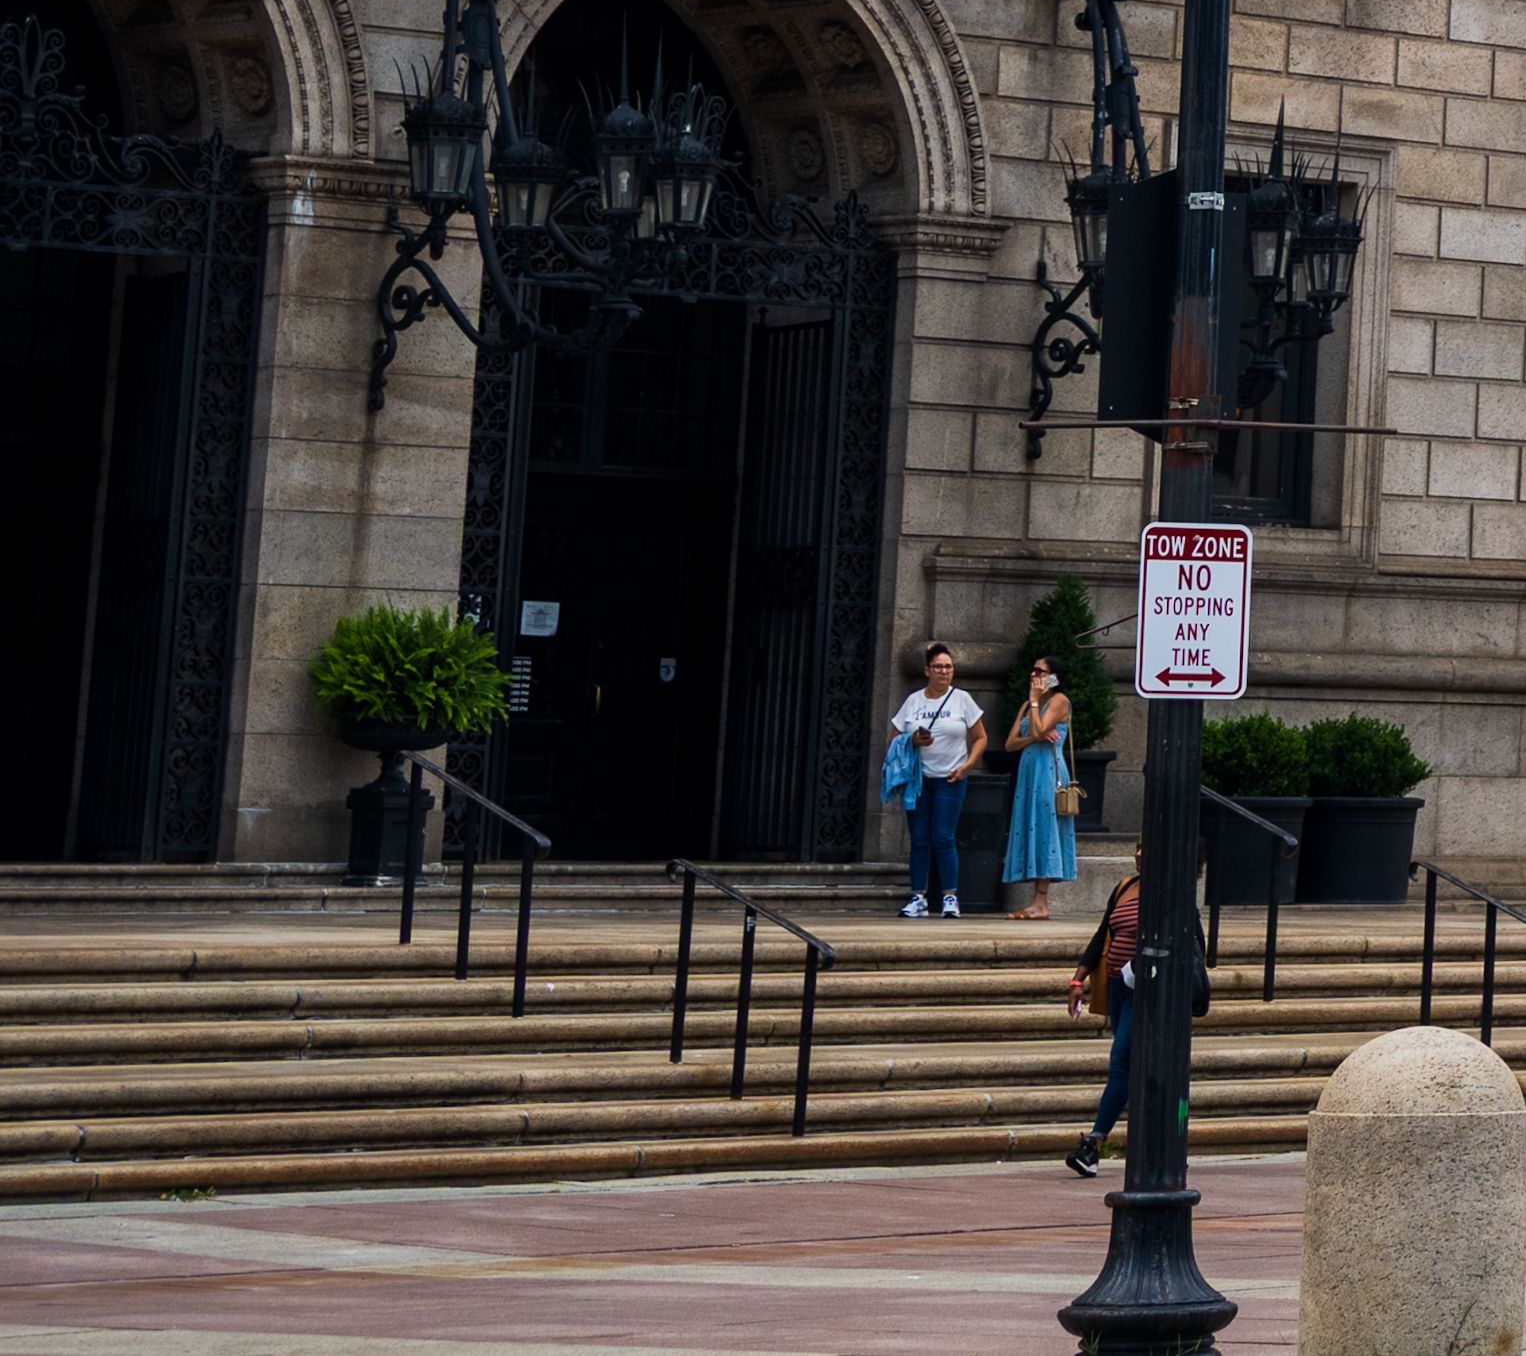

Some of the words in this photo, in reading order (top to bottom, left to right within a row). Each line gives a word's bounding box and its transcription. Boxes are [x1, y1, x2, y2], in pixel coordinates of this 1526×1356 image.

[1146, 534, 1186, 557] TOW
[1191, 535, 1244, 559] ZONE
[1177, 564, 1212, 591] NO
[1153, 596, 1234, 617] STOPPING
[1174, 623, 1210, 642] ANY
[1172, 648, 1211, 667] TIME
